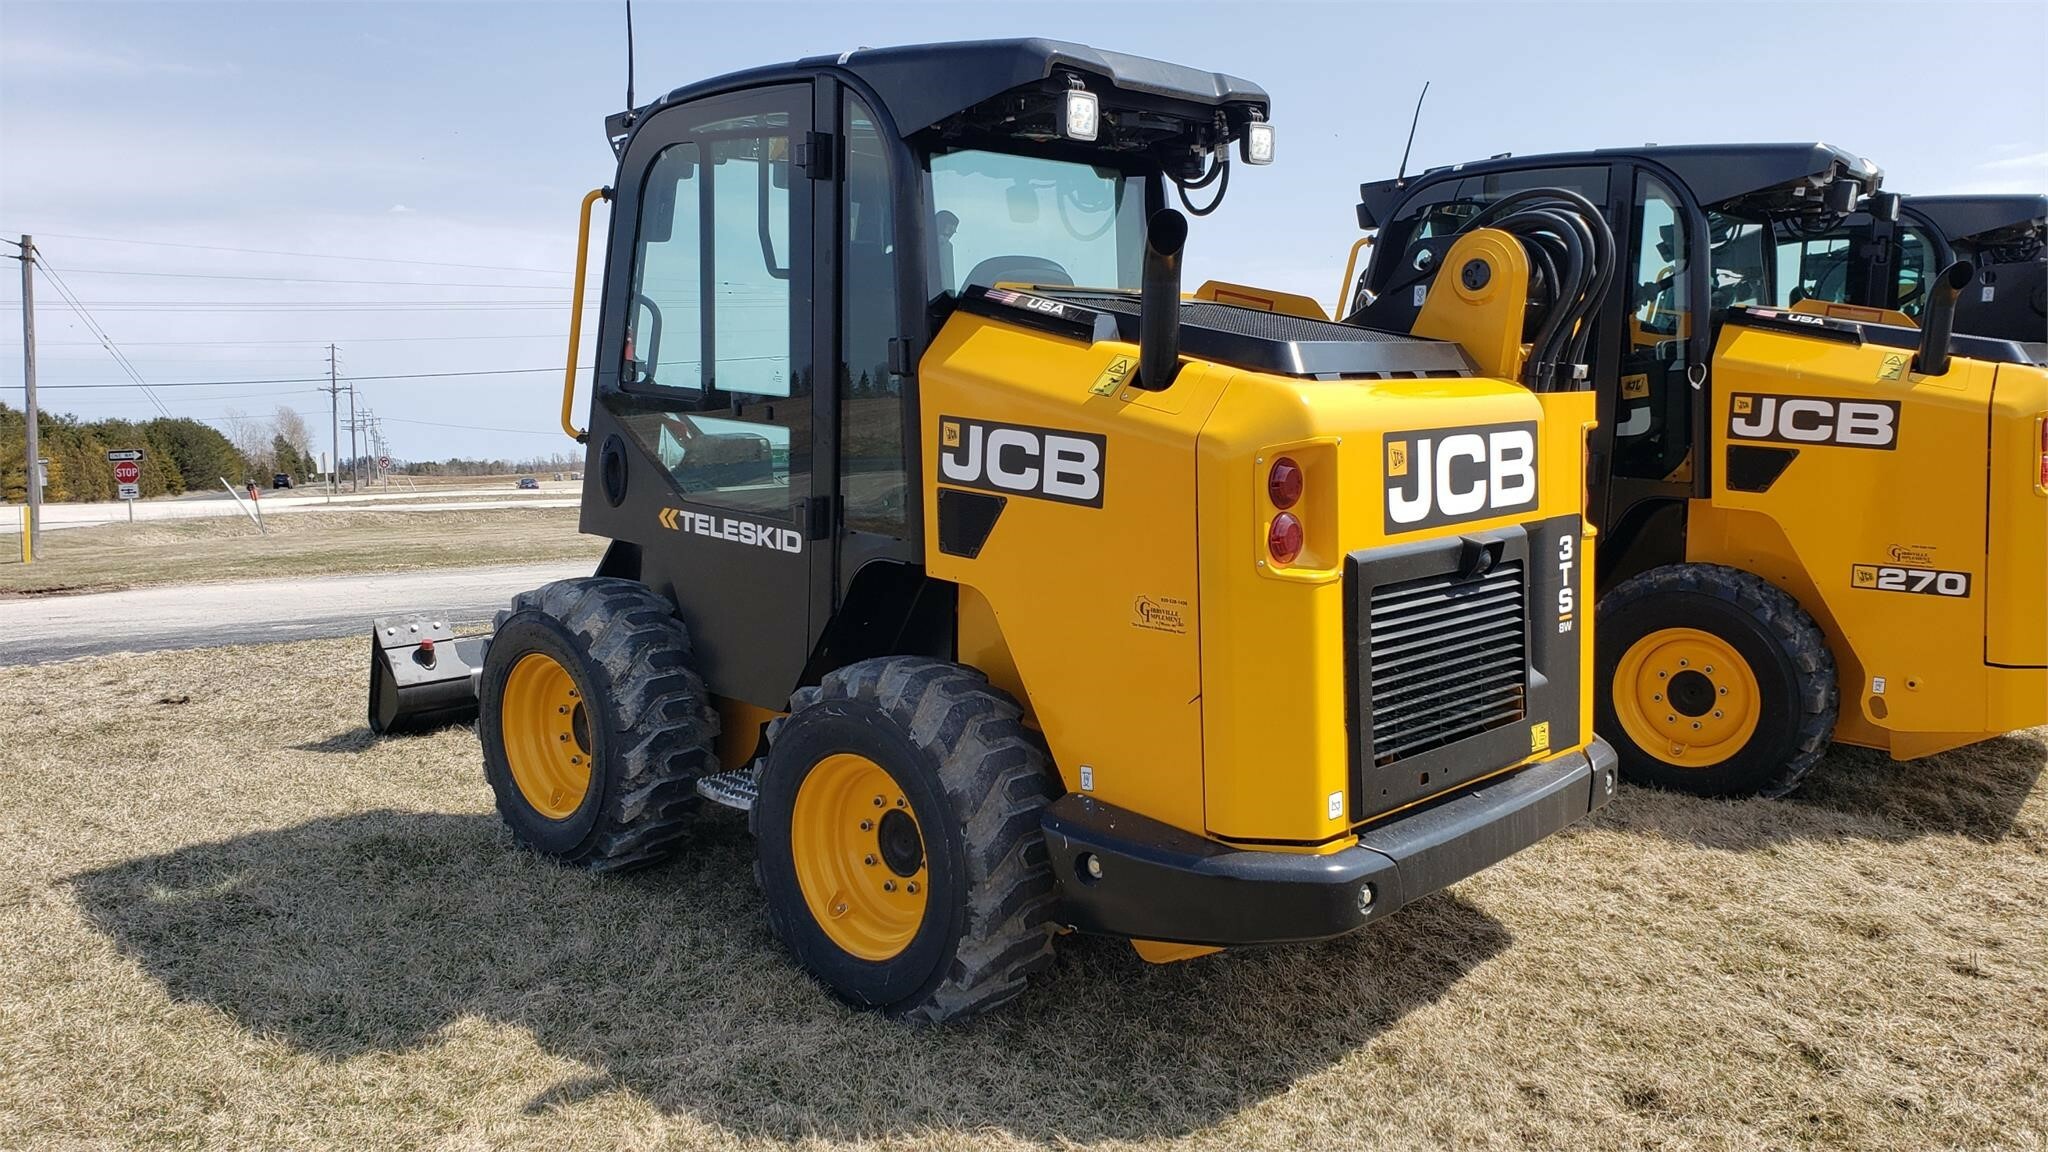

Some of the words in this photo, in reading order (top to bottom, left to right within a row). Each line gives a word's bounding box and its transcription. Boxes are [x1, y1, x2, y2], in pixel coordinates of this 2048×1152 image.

[1027, 298, 1064, 315] USA
[1787, 314, 1824, 326] USA
[1733, 398, 1894, 445] JCB
[116, 467, 138, 478] STOP
[942, 425, 1100, 500] JCB
[1389, 430, 1536, 524] JCB
[679, 510, 802, 554] TELESKID
[1559, 534, 1573, 614] 3TS
[1878, 568, 1967, 596] 270
